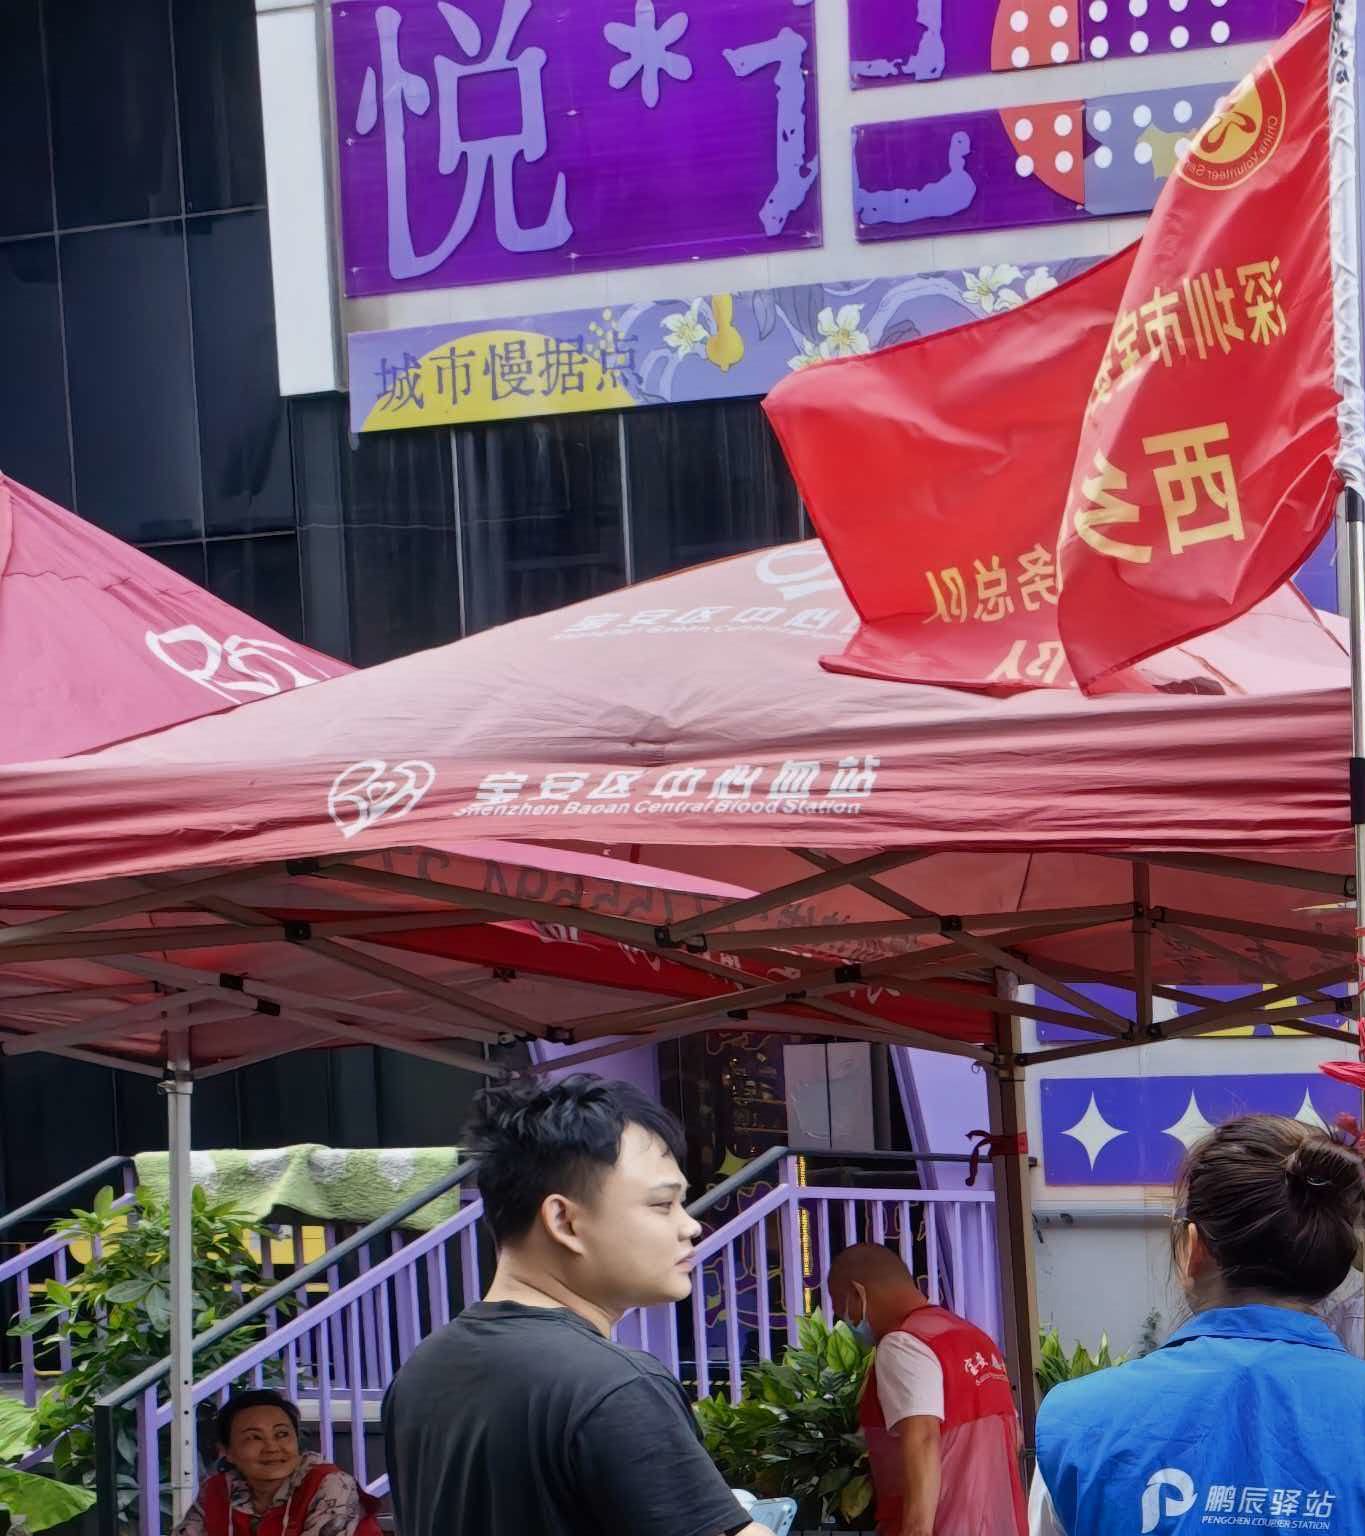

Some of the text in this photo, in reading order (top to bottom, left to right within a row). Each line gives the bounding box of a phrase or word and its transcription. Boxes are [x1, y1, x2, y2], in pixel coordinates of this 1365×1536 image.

[375, 336, 644, 412] 城市慢据点
[475, 755, 881, 801] 宝安区中心血站
[563, 801, 627, 815] Baoan
[634, 801, 711, 814] Central
[714, 800, 778, 813] Blood
[782, 800, 862, 815] Station
[1205, 1485, 1337, 1518] 鹏辰驿站
[1290, 1520, 1330, 1529] STATION
